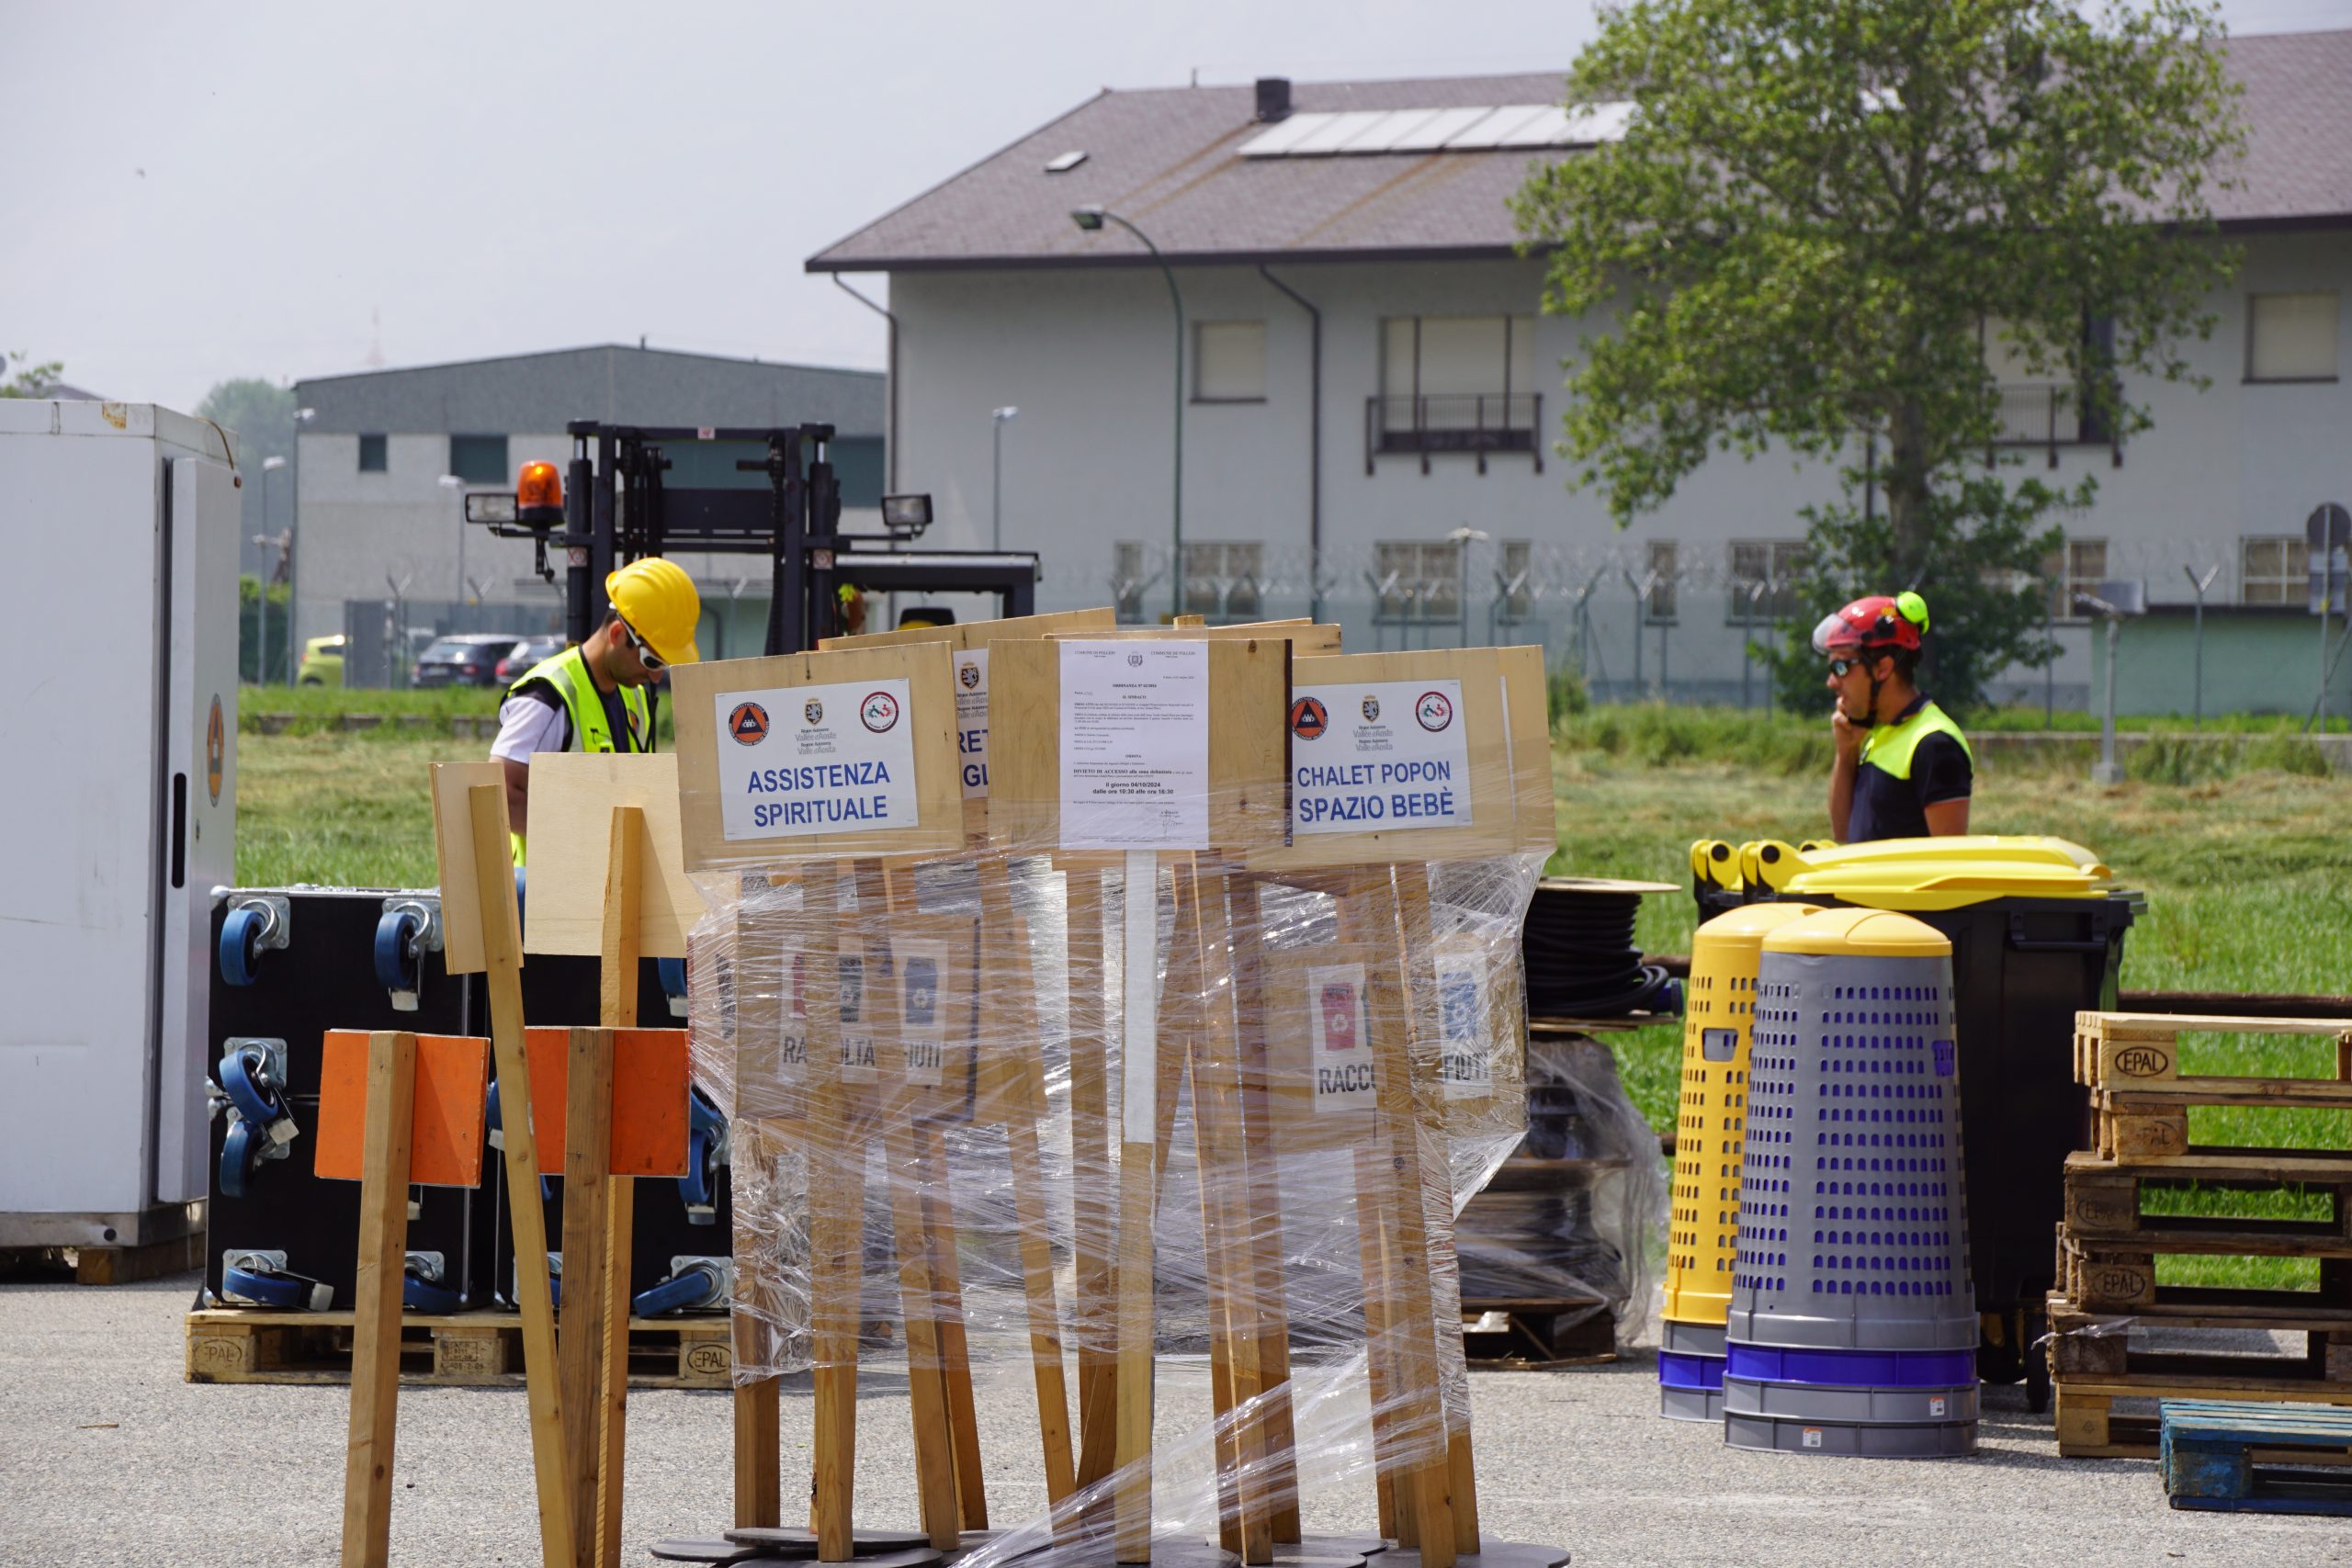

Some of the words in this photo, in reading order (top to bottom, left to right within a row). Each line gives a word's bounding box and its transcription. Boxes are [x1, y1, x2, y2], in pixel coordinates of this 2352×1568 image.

[747, 761, 890, 793] ASSISTENZA
[1297, 764, 1376, 788] CHALET
[1381, 761, 1451, 784] POPON
[754, 795, 888, 827] SPIRITUALE
[1299, 794, 1384, 823] SPAZIO
[1392, 786, 1454, 818] BEBÈ
[2124, 1052, 2158, 1072] EPAL
[2104, 1275, 2137, 1293] EPAL
[695, 1352, 726, 1367] EPAL
